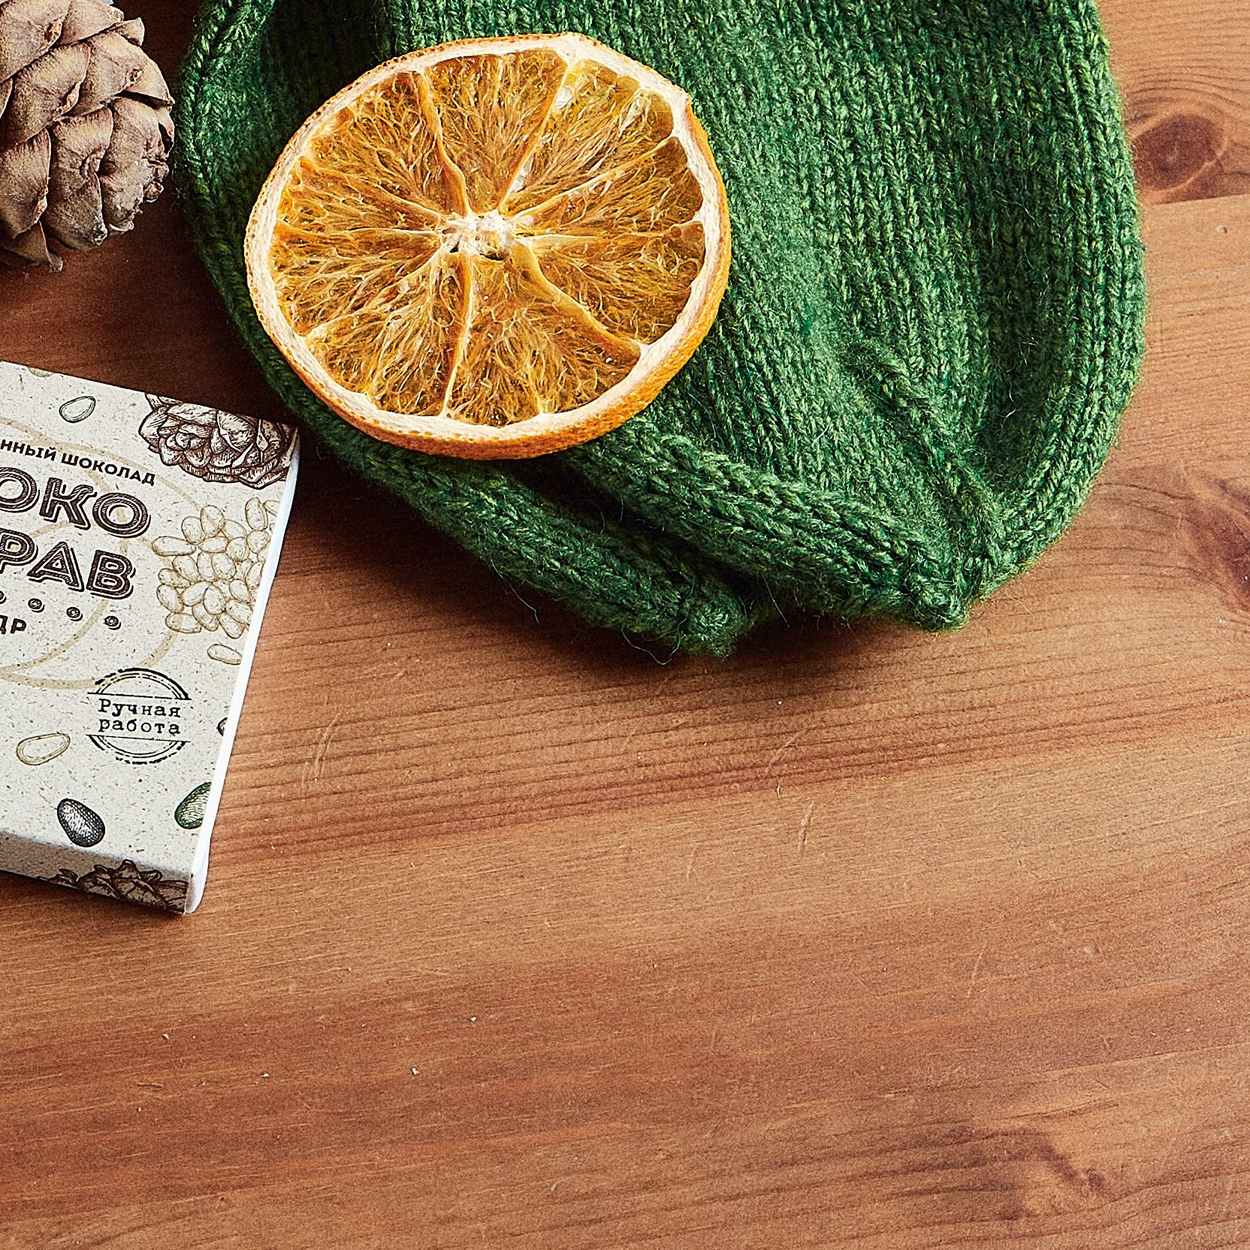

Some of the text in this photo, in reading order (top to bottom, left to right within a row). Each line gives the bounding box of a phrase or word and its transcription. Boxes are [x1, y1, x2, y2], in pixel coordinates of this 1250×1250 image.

[60, 451, 157, 487] ШОКОЛАД
[97, 698, 182, 719] Ручная
[98, 718, 181, 736] работа
